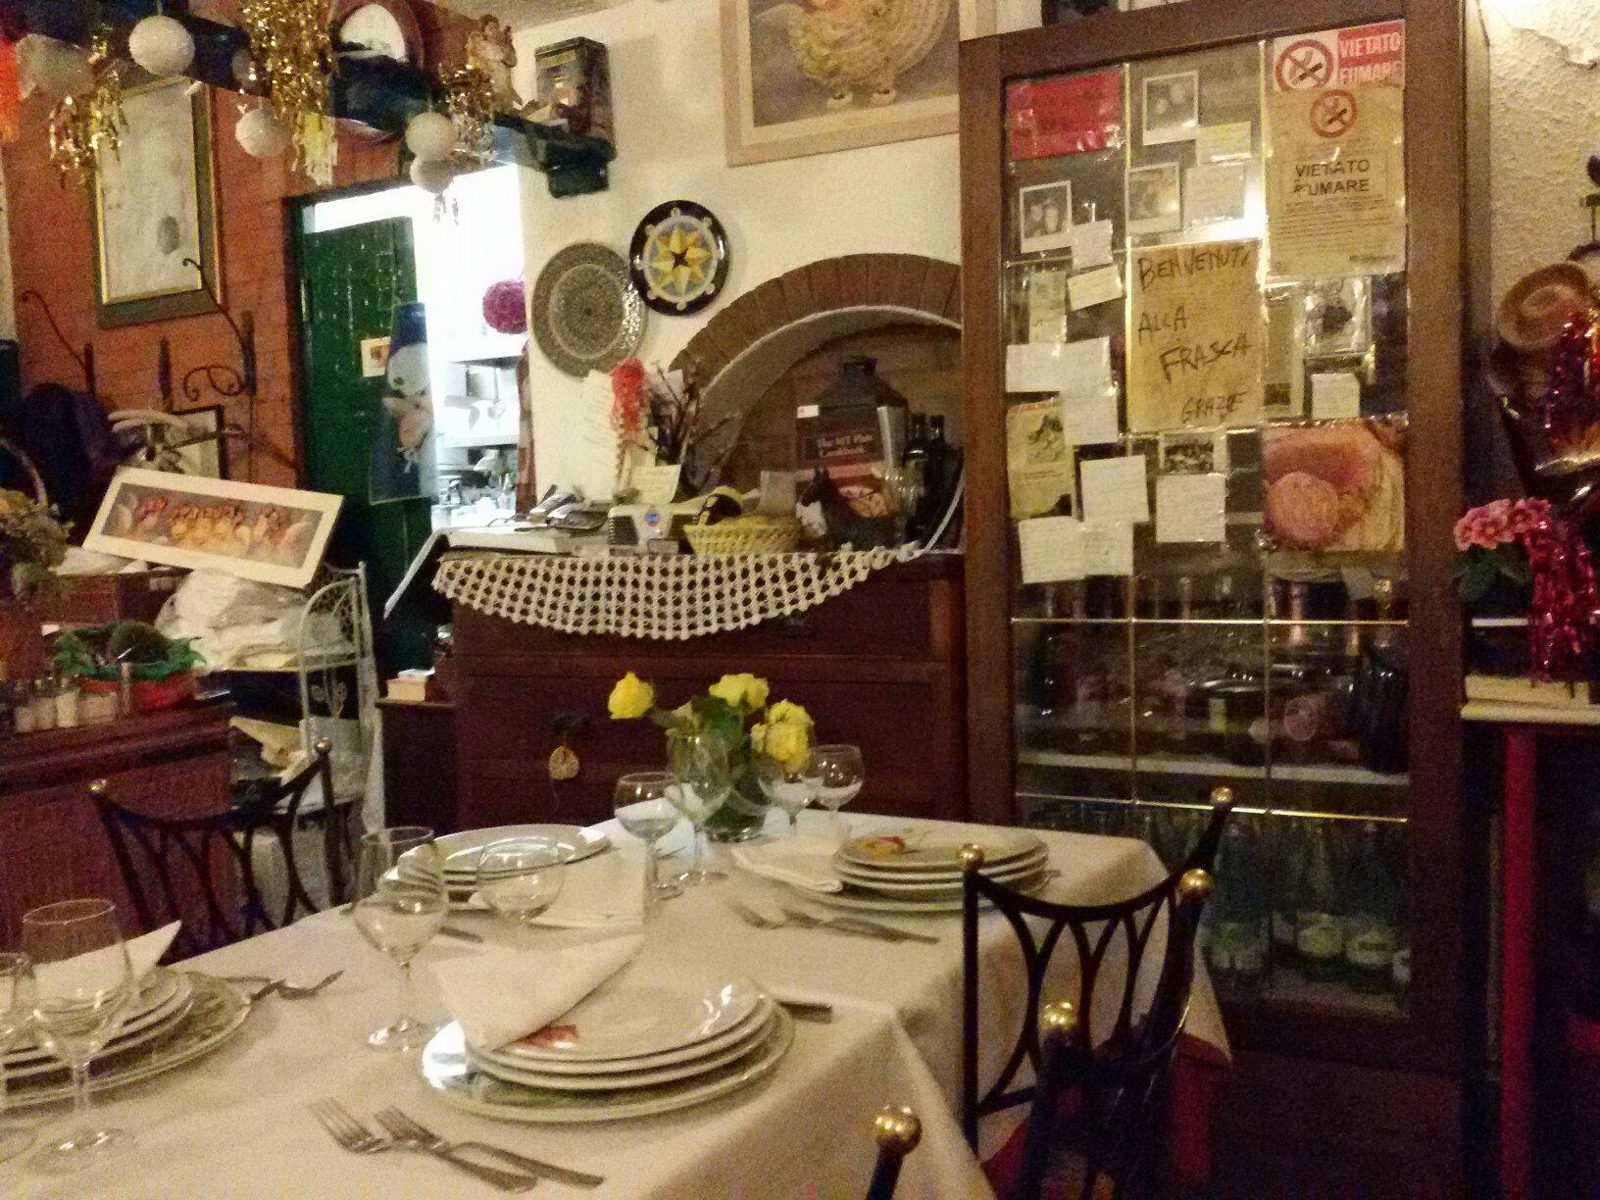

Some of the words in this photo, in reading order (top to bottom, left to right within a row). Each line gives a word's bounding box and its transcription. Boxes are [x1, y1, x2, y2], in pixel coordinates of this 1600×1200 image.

[1295, 159, 1370, 177] VIETATO
[1293, 178, 1370, 196] FUMARE
[1138, 305, 1189, 345] ALLA
[1159, 332, 1253, 384] FRASCA
